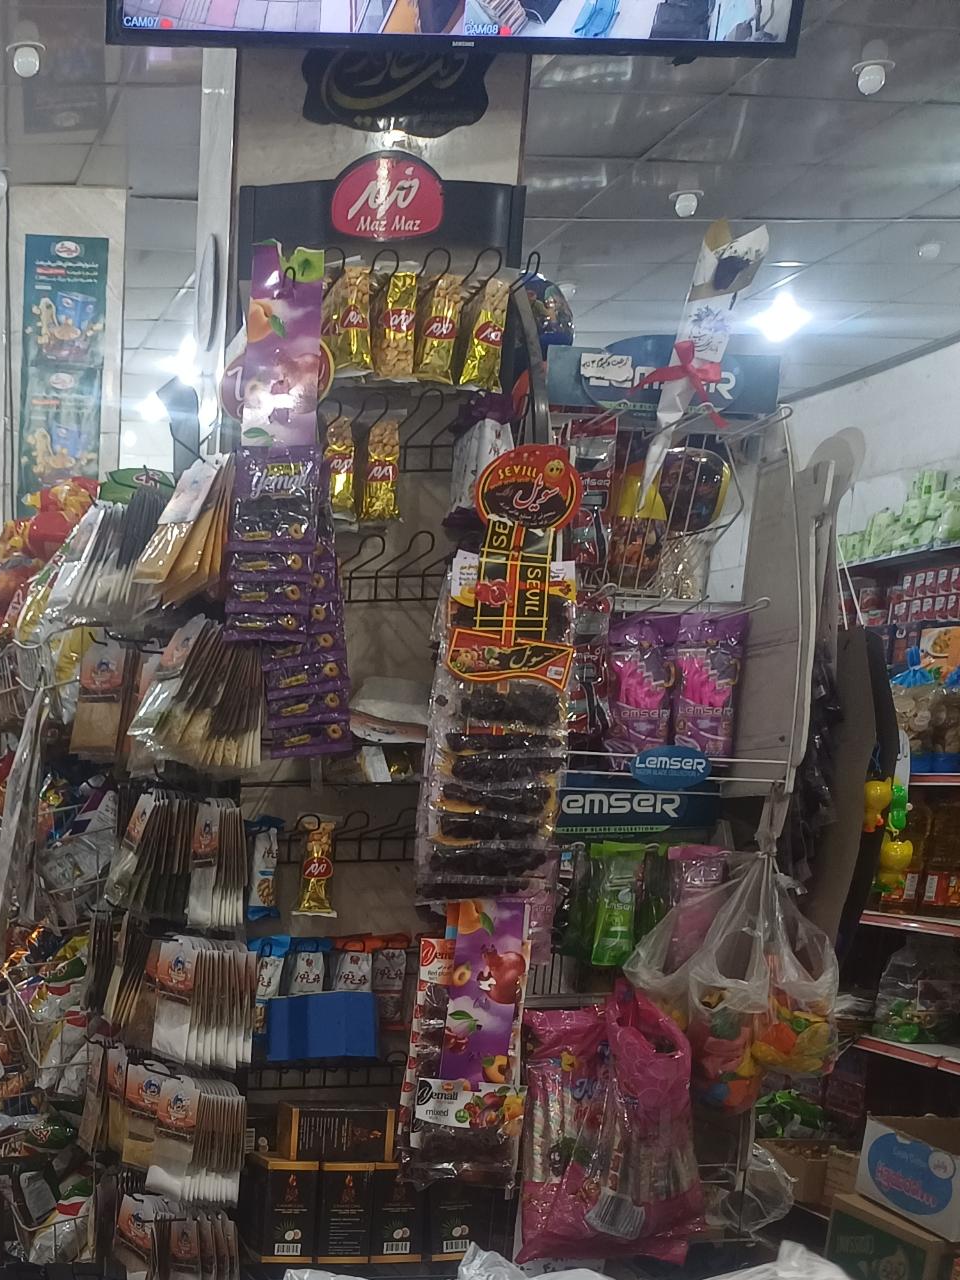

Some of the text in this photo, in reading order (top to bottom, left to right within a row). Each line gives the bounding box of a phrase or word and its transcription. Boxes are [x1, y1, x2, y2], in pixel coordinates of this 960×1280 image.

[123, 17, 159, 27] CAM07
[465, 24, 498, 35] CAM08
[356, 216, 421, 232] Maz Maz
